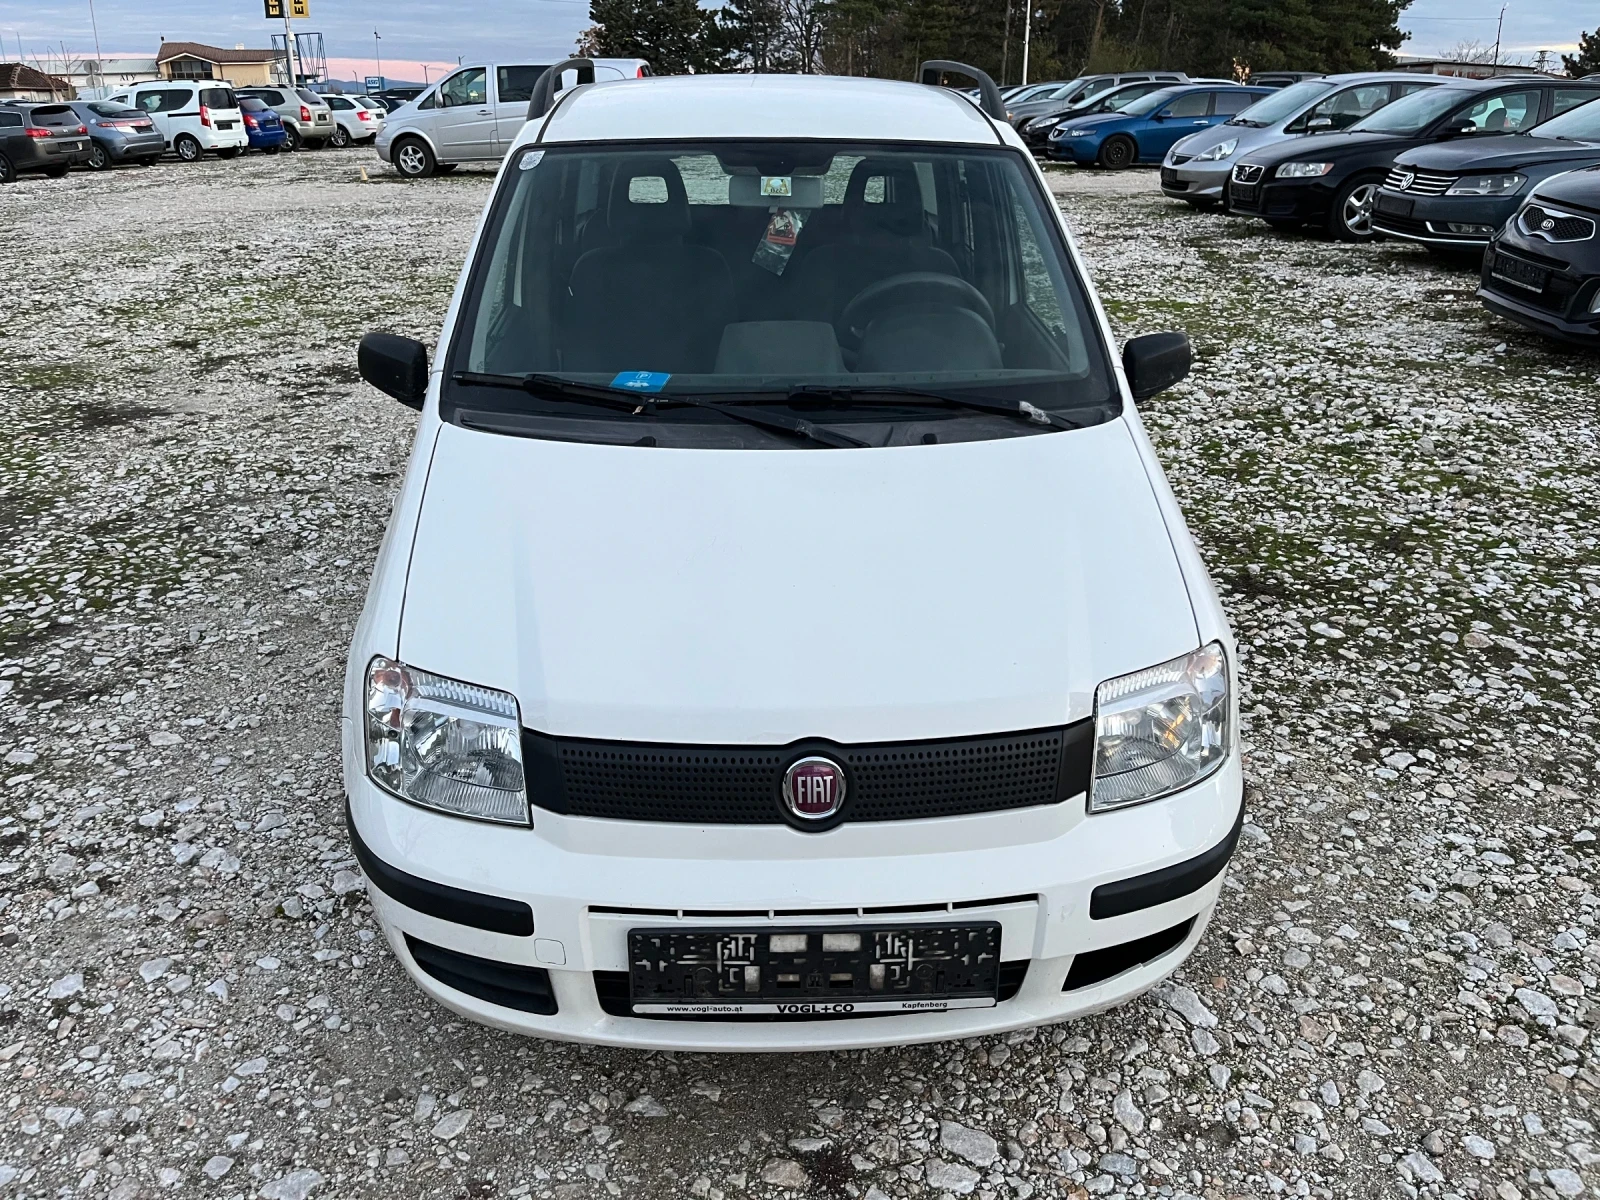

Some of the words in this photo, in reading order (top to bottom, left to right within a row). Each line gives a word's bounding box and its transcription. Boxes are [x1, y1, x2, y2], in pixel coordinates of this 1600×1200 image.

[797, 775, 834, 804] FIAT
[666, 1005, 743, 1013] www.vogl-auto.at
[776, 1003, 855, 1013] VOGL+CO
[901, 1001, 948, 1009] Kapfenberg
